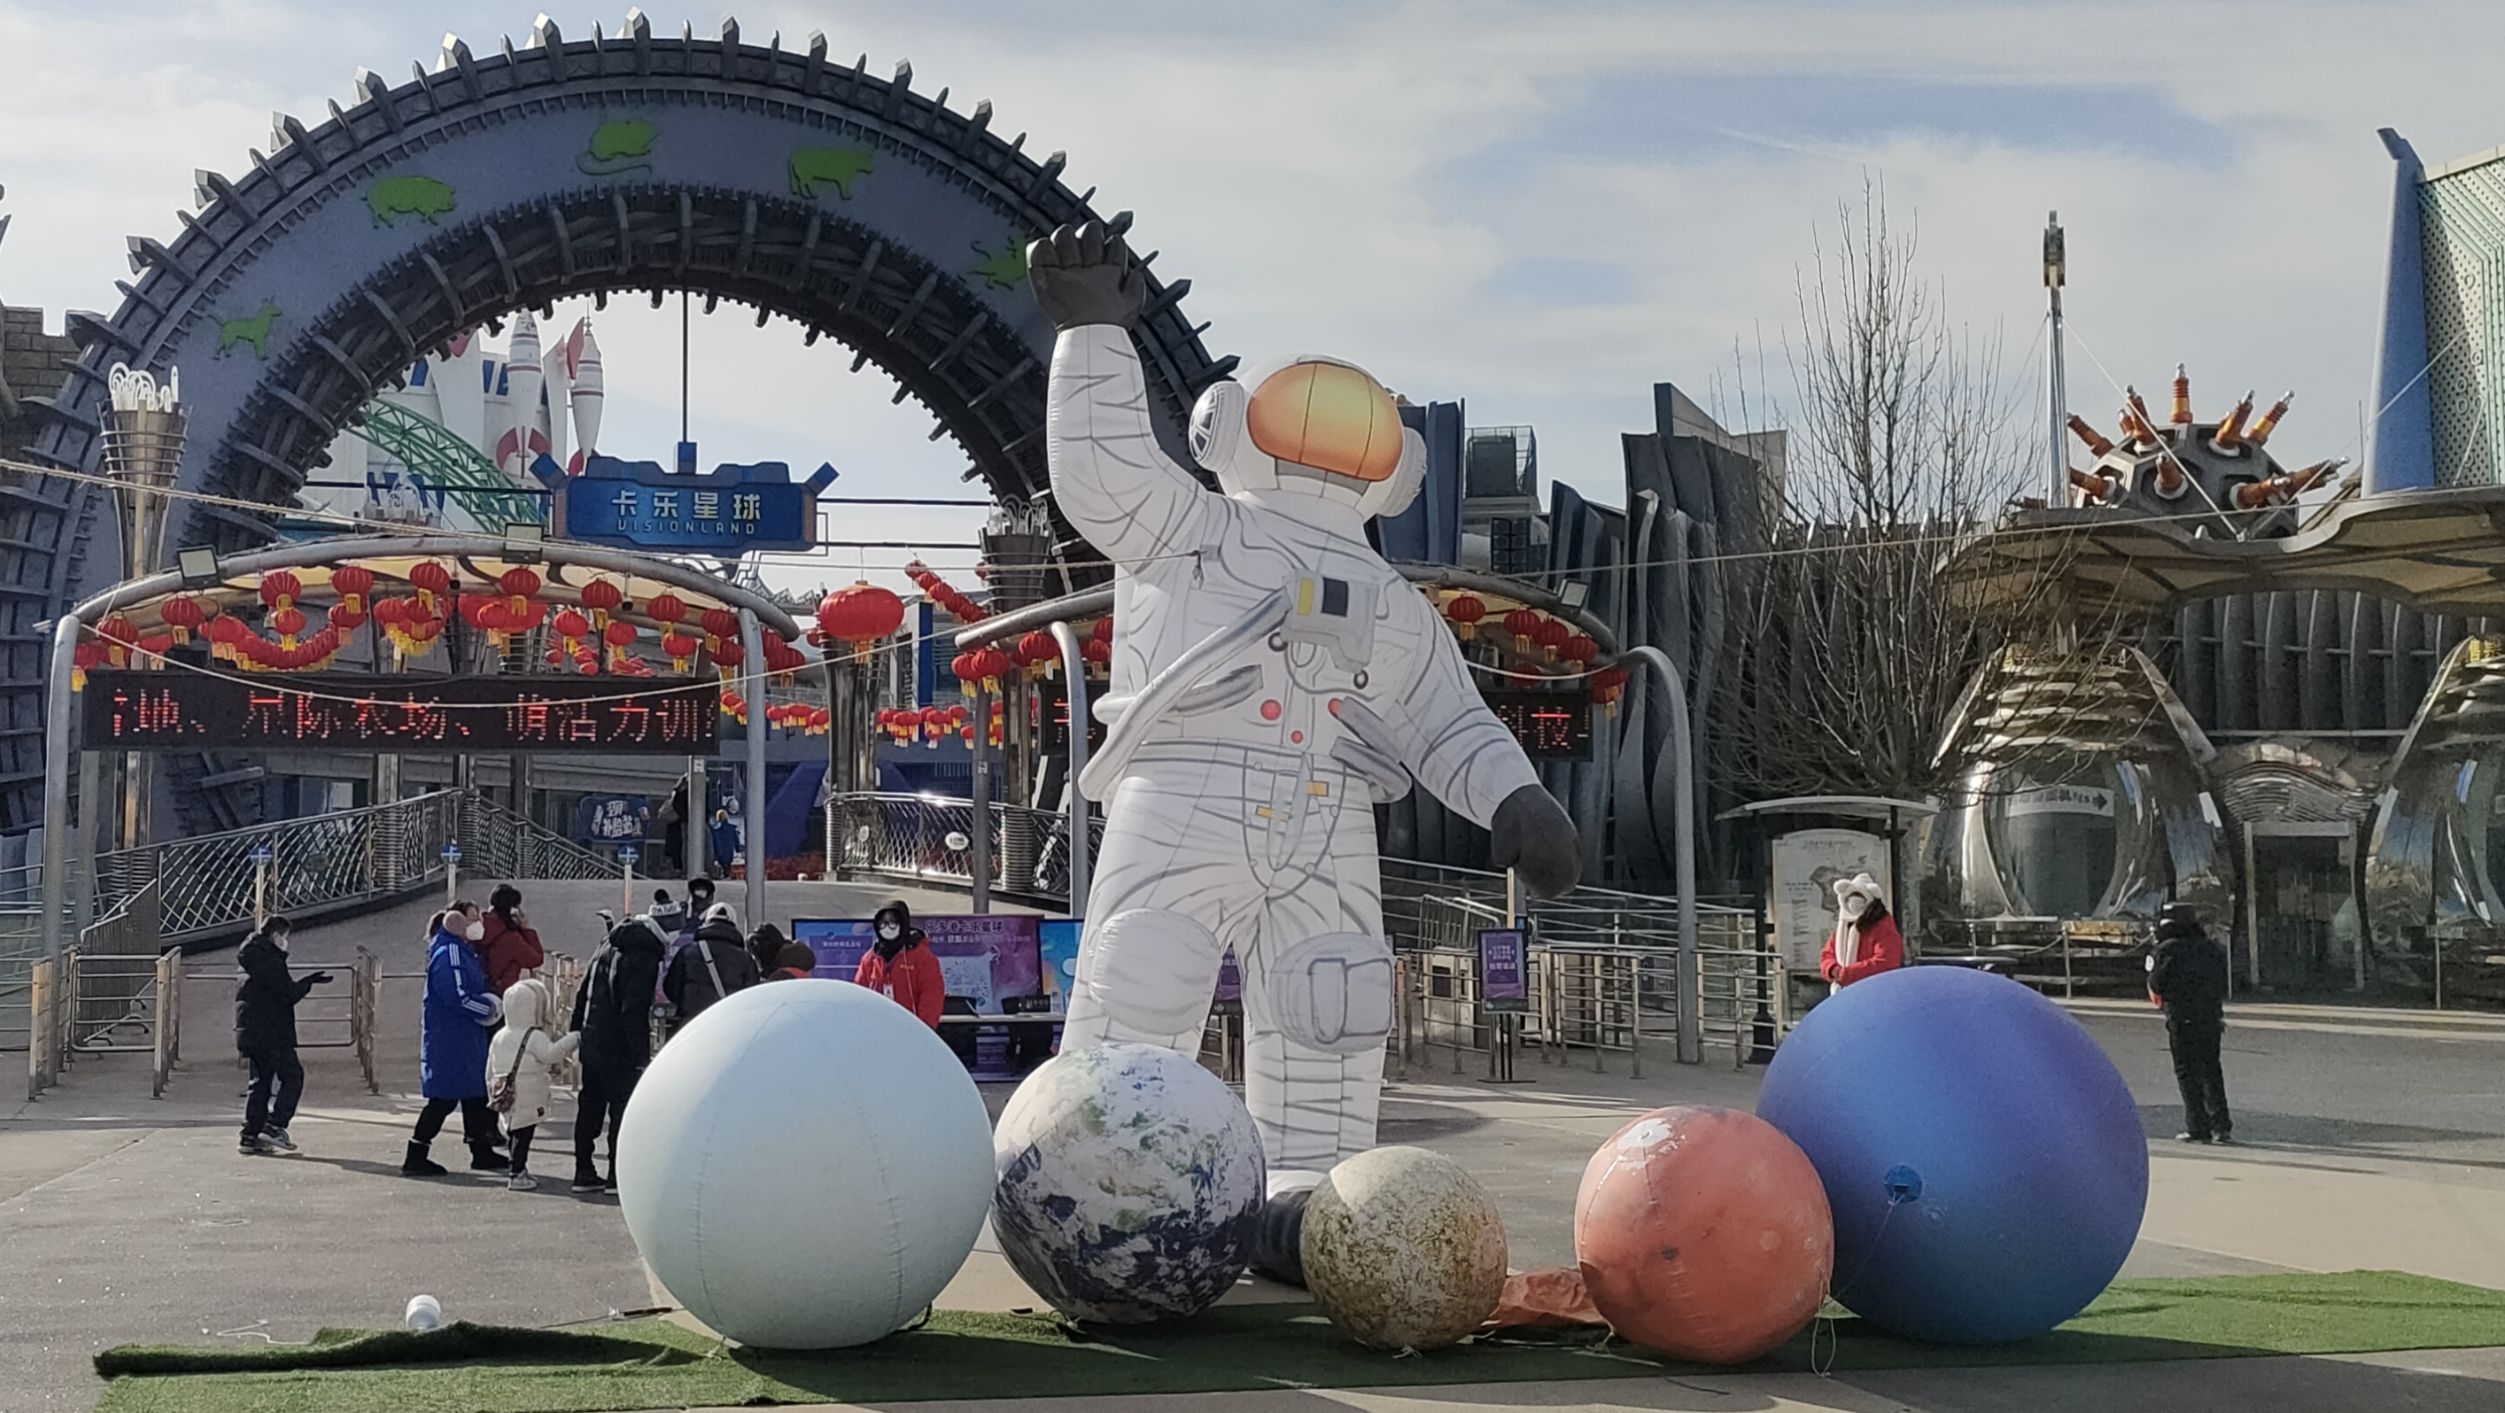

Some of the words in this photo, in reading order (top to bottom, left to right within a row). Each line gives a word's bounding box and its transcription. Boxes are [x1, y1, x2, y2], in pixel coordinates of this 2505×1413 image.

[612, 489, 761, 521] 卡乐星球
[618, 519, 755, 535] VISIONLAND
